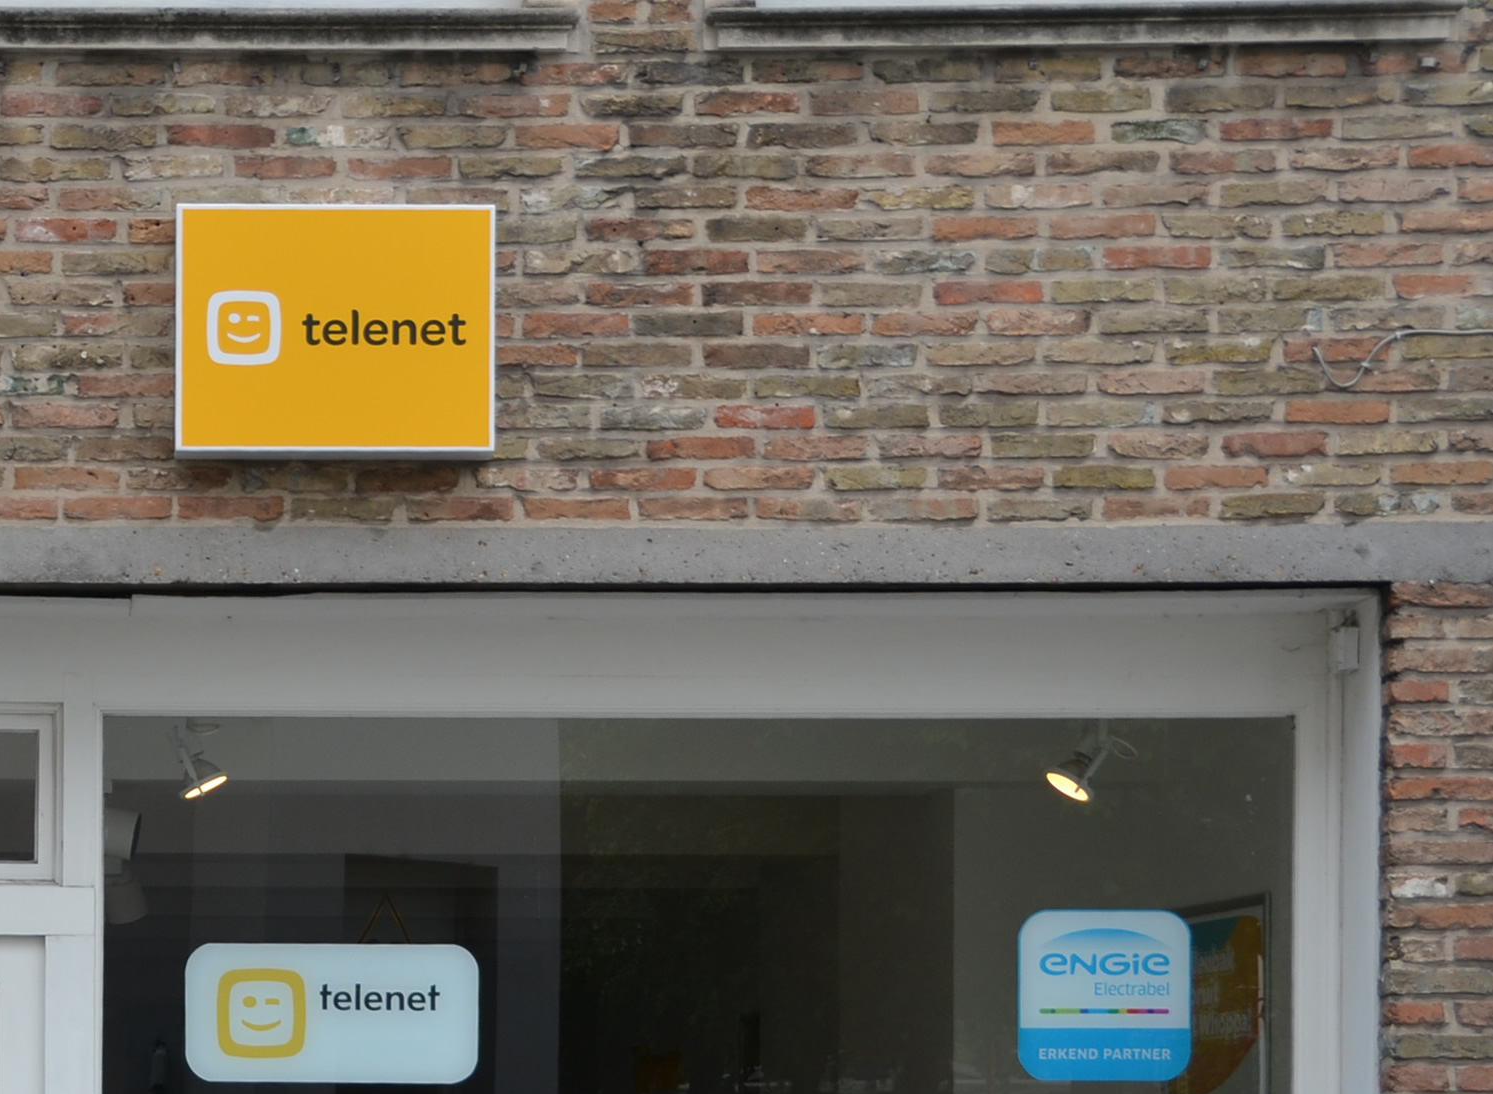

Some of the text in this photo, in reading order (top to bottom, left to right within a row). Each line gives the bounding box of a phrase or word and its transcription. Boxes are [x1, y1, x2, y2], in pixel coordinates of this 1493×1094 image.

[302, 309, 466, 346] telenet
[320, 983, 440, 1011] telenet
[1094, 982, 1170, 996] Electrabel
[1038, 1048, 1171, 1060] ERKEND PARTNER
